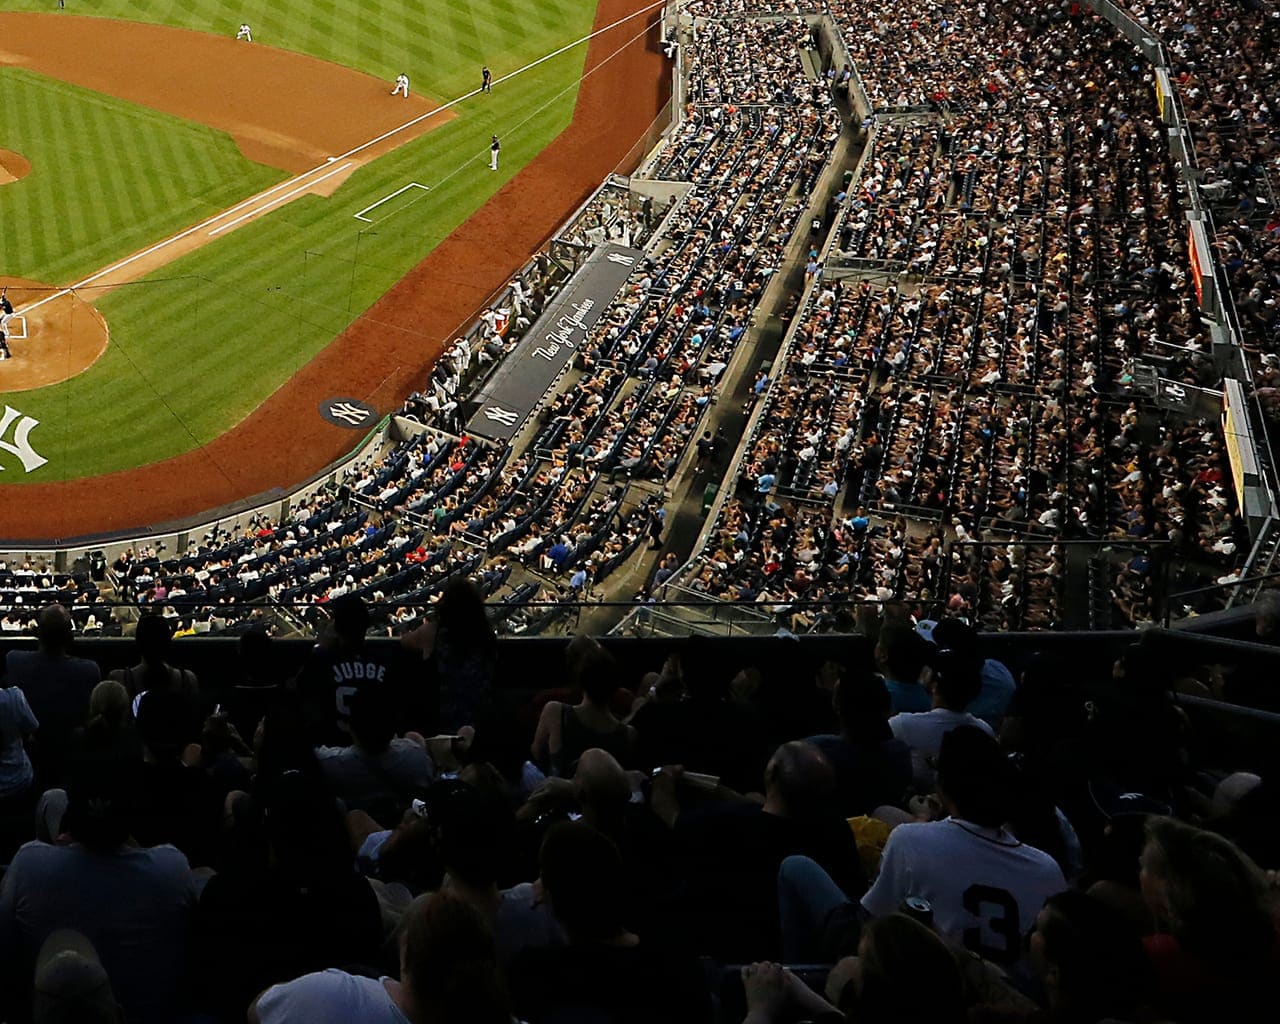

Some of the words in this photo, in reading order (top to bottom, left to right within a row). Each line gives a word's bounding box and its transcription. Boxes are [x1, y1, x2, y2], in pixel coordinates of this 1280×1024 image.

[564, 298, 595, 330] Yankees
[331, 660, 387, 684] JUDGE
[962, 882, 1020, 958] 3
